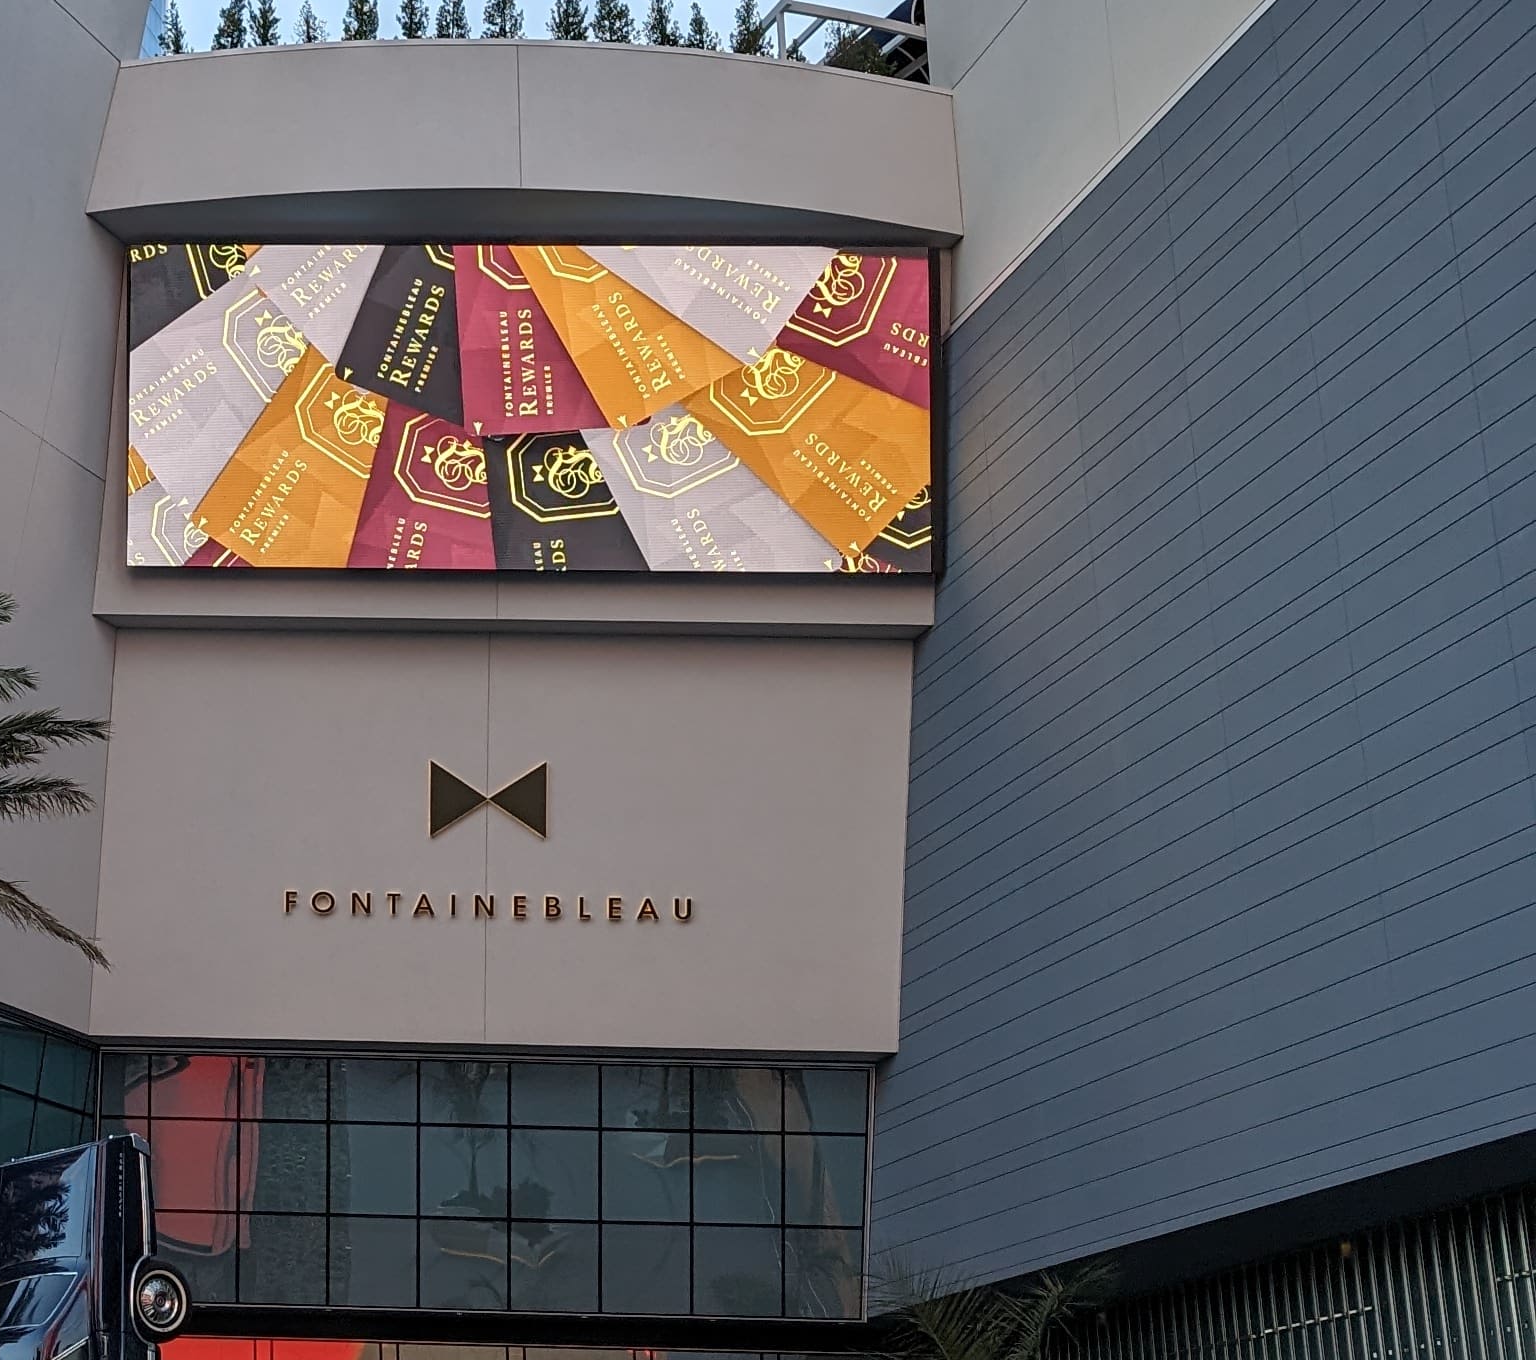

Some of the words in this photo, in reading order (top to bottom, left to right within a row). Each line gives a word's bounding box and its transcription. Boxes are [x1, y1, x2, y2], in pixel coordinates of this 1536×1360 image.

[377, 277, 424, 379] FONTAINEBLEAU
[673, 258, 768, 325] FONTAINEBLEAU
[390, 284, 446, 388] REWARDS
[414, 345, 440, 393] PREMIER
[499, 311, 514, 417] FONTAINEBLEAU
[517, 308, 539, 417] REWARDS
[591, 304, 651, 401] FONTAINEBLEAU
[607, 291, 672, 395] REWARDS
[656, 334, 686, 380] PREMIER
[130, 361, 218, 428] REWARDS
[543, 365, 554, 416] PREMIER
[229, 450, 289, 534] FONTAINEBLEAU
[239, 459, 308, 547] REWARDS
[792, 449, 873, 523] FONTAINEBLEAU
[805, 432, 888, 513] REWARDS
[860, 458, 898, 495] PREMIER
[260, 514, 290, 555] PREMIER
[283, 890, 695, 922] FONTAINEBLEAU
